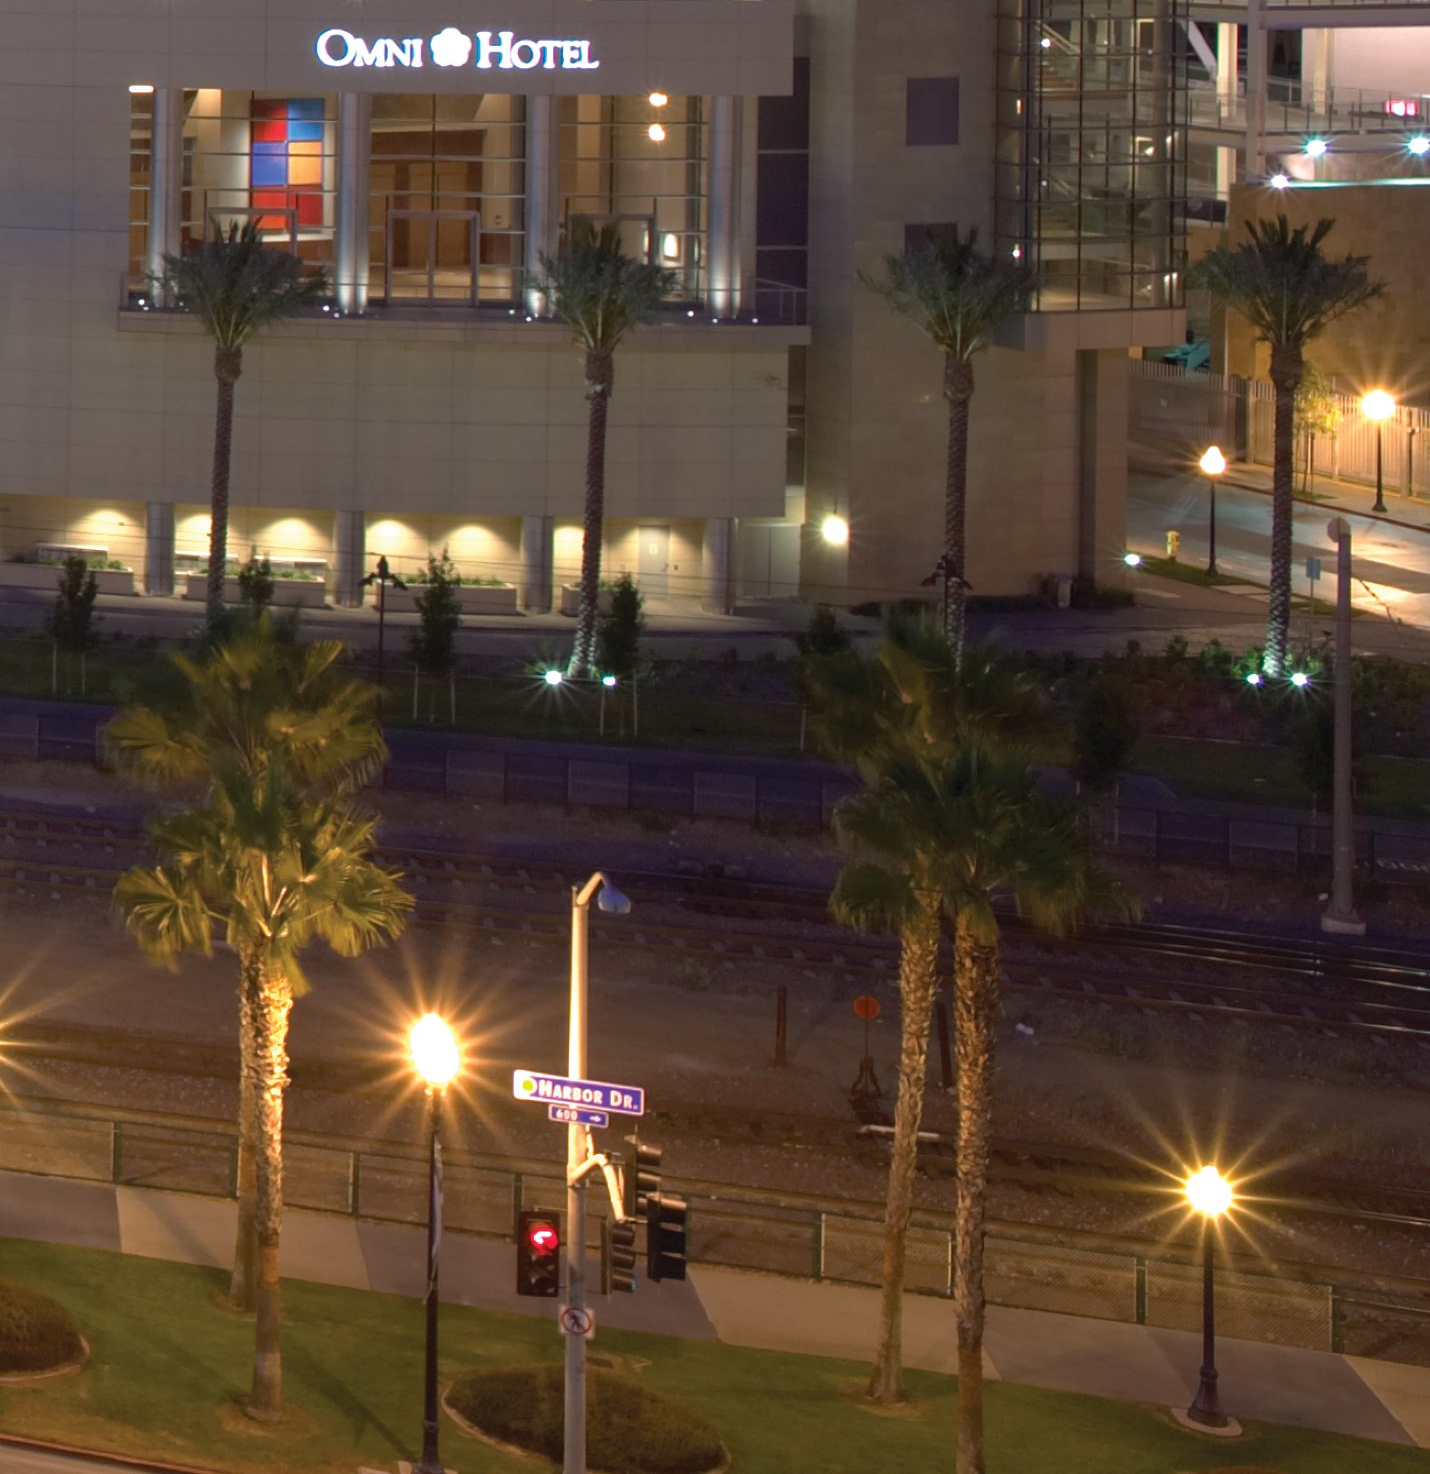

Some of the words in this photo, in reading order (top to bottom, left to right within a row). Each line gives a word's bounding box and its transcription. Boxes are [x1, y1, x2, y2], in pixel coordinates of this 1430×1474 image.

[316, 28, 423, 67] OMNI
[477, 31, 600, 69] HOTEL
[538, 1079, 602, 1104] HARBOR
[556, 1110, 578, 1121] 600
